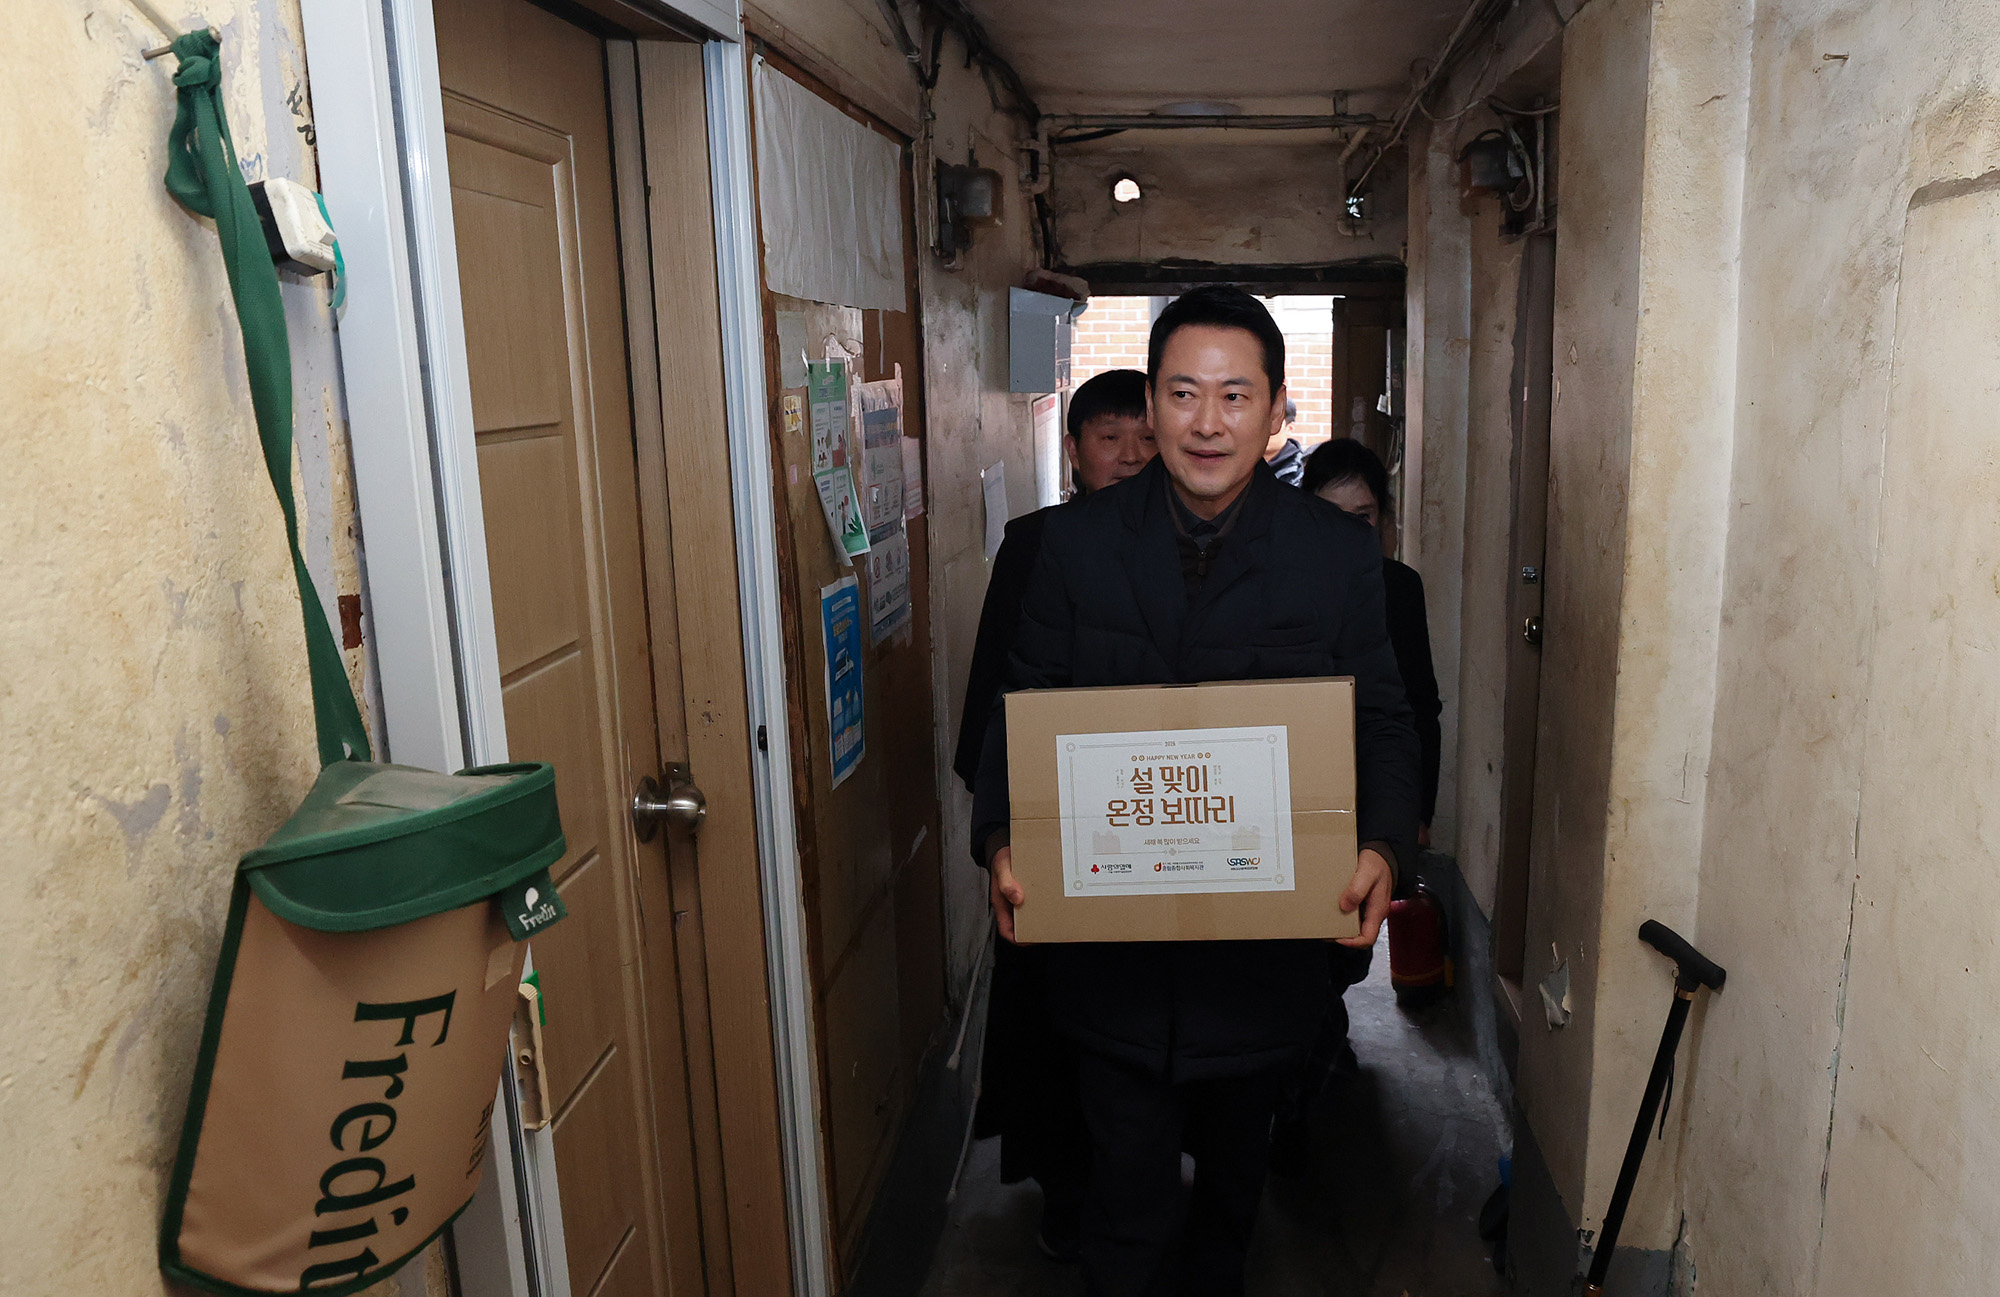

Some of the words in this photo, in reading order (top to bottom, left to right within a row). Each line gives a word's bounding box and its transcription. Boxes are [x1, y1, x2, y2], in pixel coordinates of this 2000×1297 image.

[1130, 767, 1154, 794] 설
[1159, 765, 1208, 793] 맞이
[1106, 799, 1154, 827] 온정
[1160, 795, 1235, 825] 보따리
[1143, 838, 1156, 846] 새해
[1163, 838, 1175, 846] 많이
[1176, 837, 1200, 846] 받으세요
[518, 903, 557, 931] Fredit
